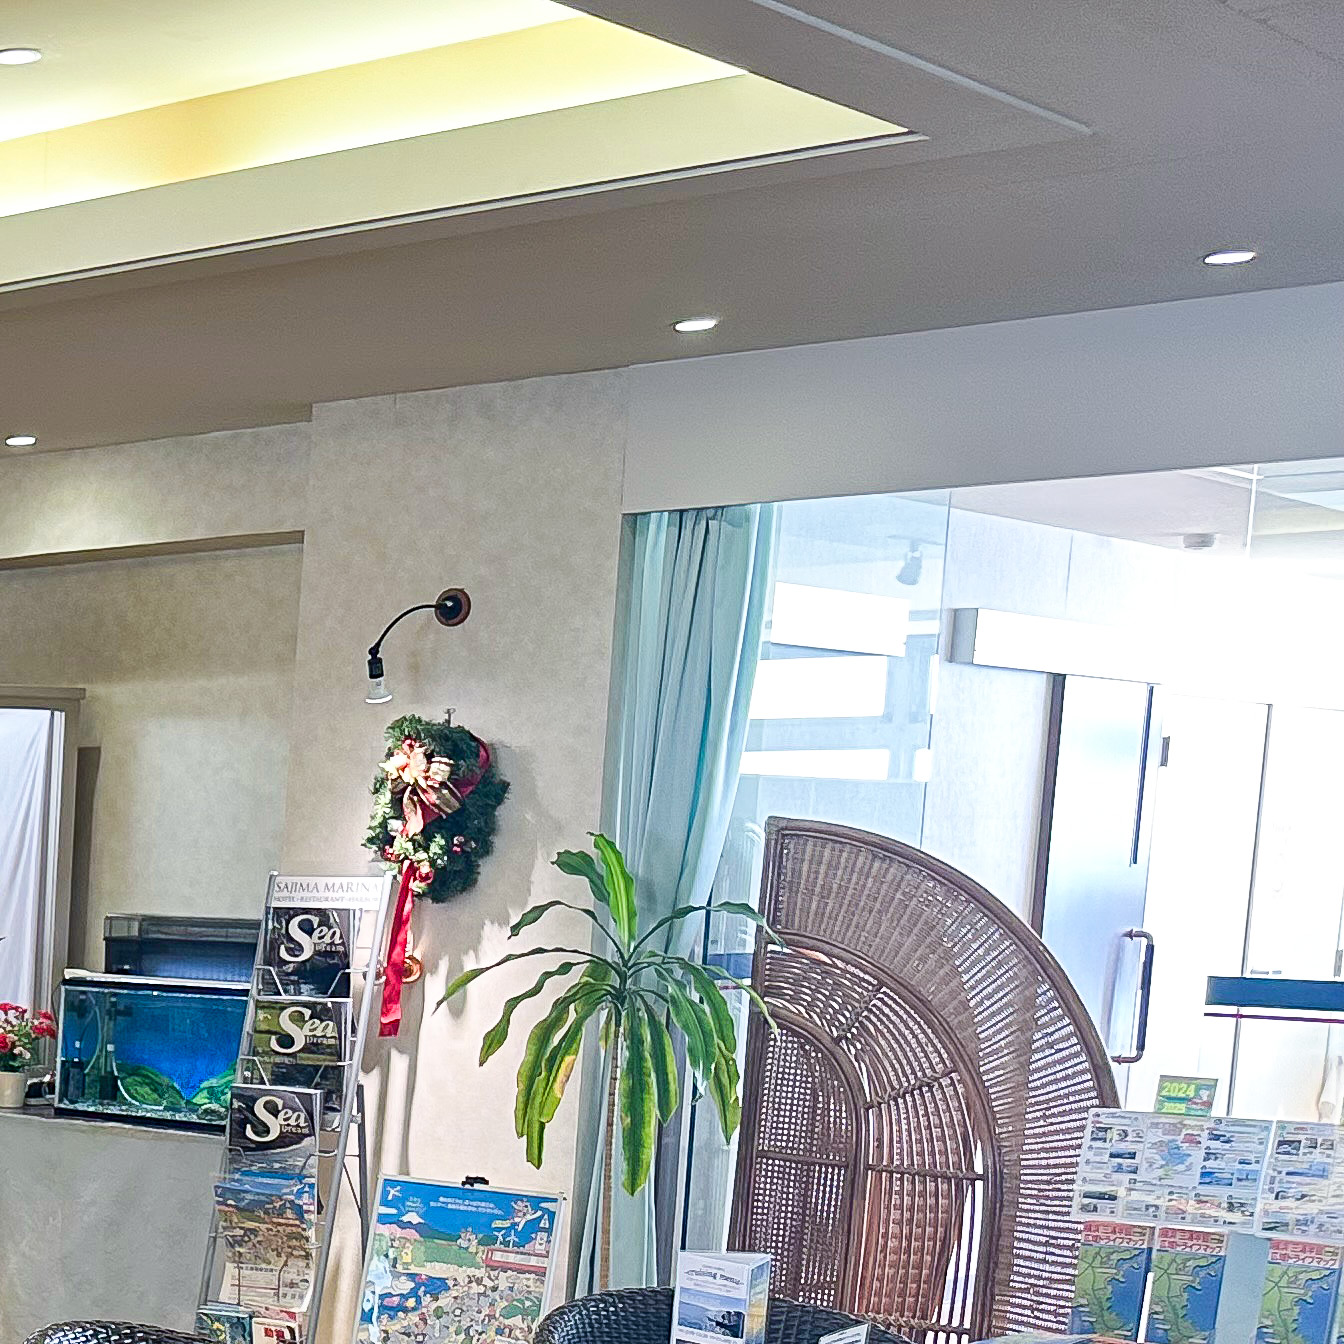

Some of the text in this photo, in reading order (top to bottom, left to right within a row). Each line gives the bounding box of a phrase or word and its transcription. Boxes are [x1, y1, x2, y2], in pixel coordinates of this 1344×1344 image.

[275, 881, 320, 894] SAJIMA
[279, 914, 343, 962] Sea
[270, 1006, 338, 1054] Sea
[1160, 1081, 1196, 1098] 2024
[245, 1096, 309, 1142] Sea
